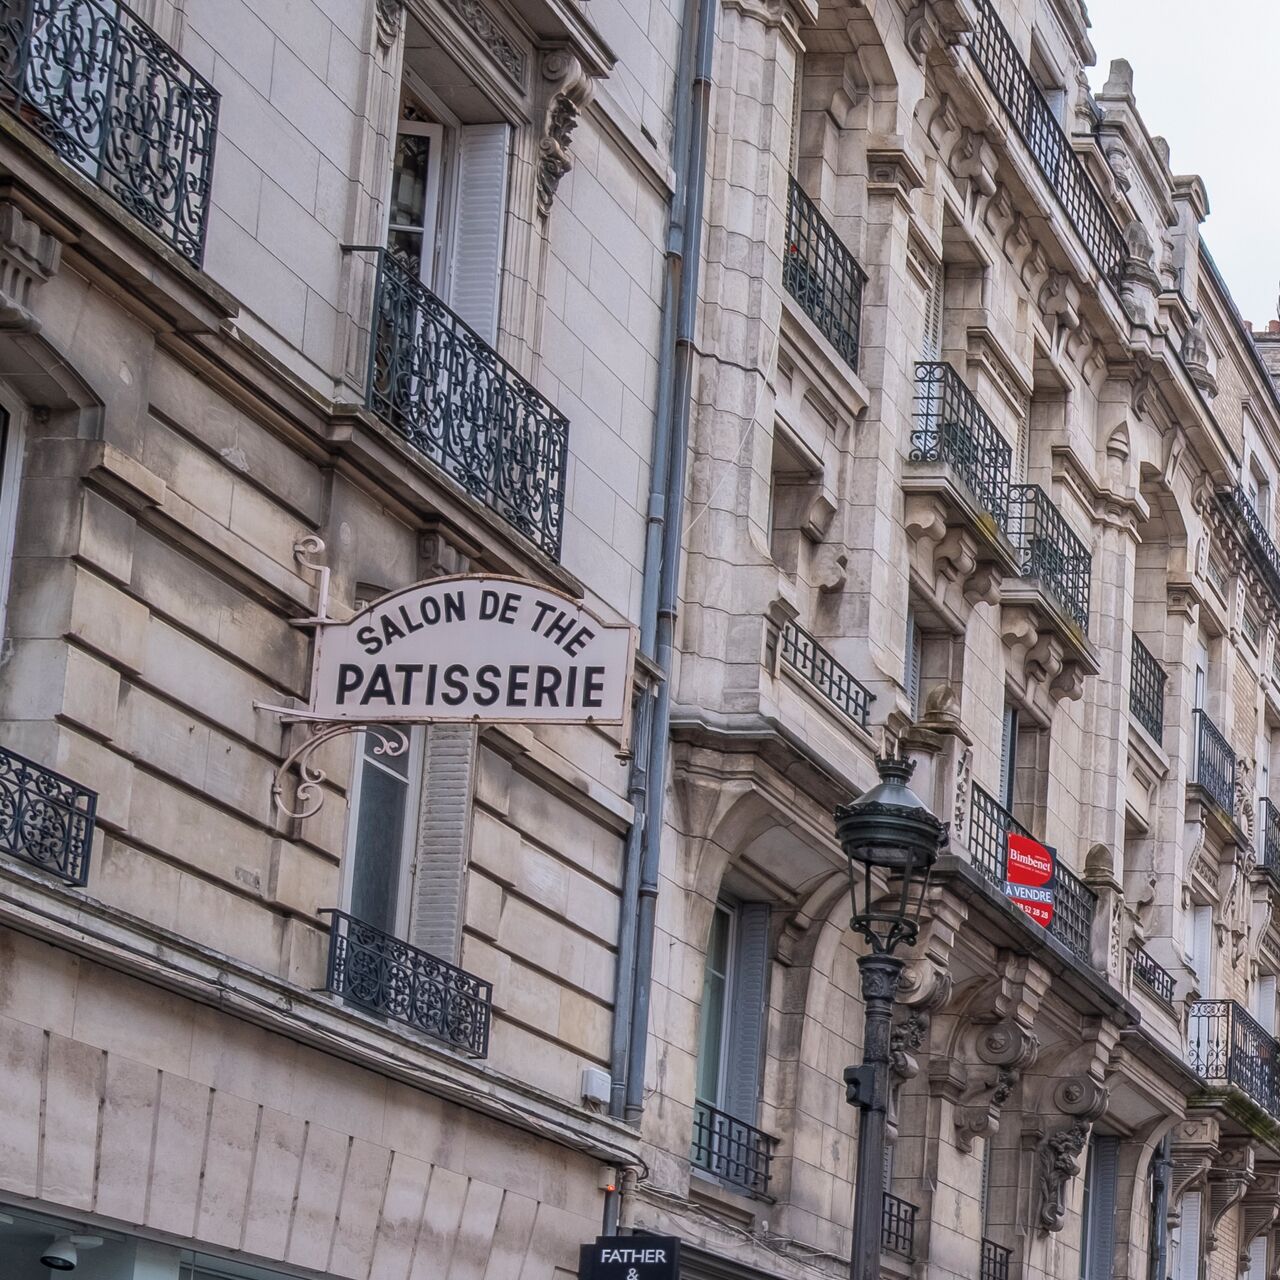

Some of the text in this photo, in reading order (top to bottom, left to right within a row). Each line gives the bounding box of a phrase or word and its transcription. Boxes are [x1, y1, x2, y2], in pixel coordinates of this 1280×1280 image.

[356, 590, 595, 657] SALON DE THE
[336, 663, 606, 708] PATISSERIE
[1010, 848, 1050, 872] Bimbenet
[1005, 881, 1052, 903] À VENDRE
[600, 1248, 667, 1263] FATHER
